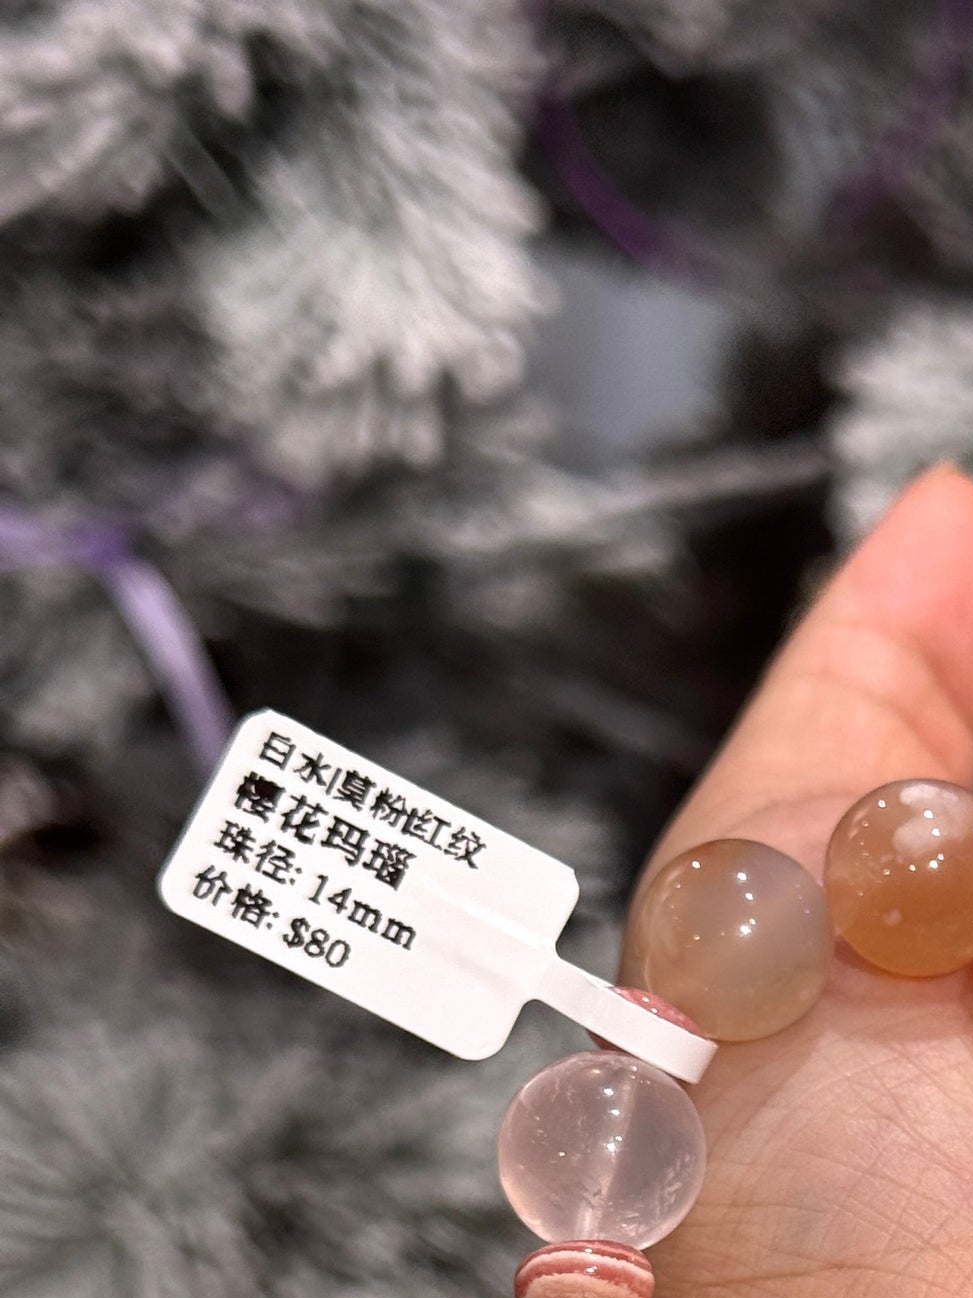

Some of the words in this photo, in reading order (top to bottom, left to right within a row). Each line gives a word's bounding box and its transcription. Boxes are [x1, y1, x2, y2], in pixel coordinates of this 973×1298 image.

[234, 771, 417, 891] 樱花玛瑙
[282, 916, 352, 968] $80
[308, 874, 417, 951] 14mm
